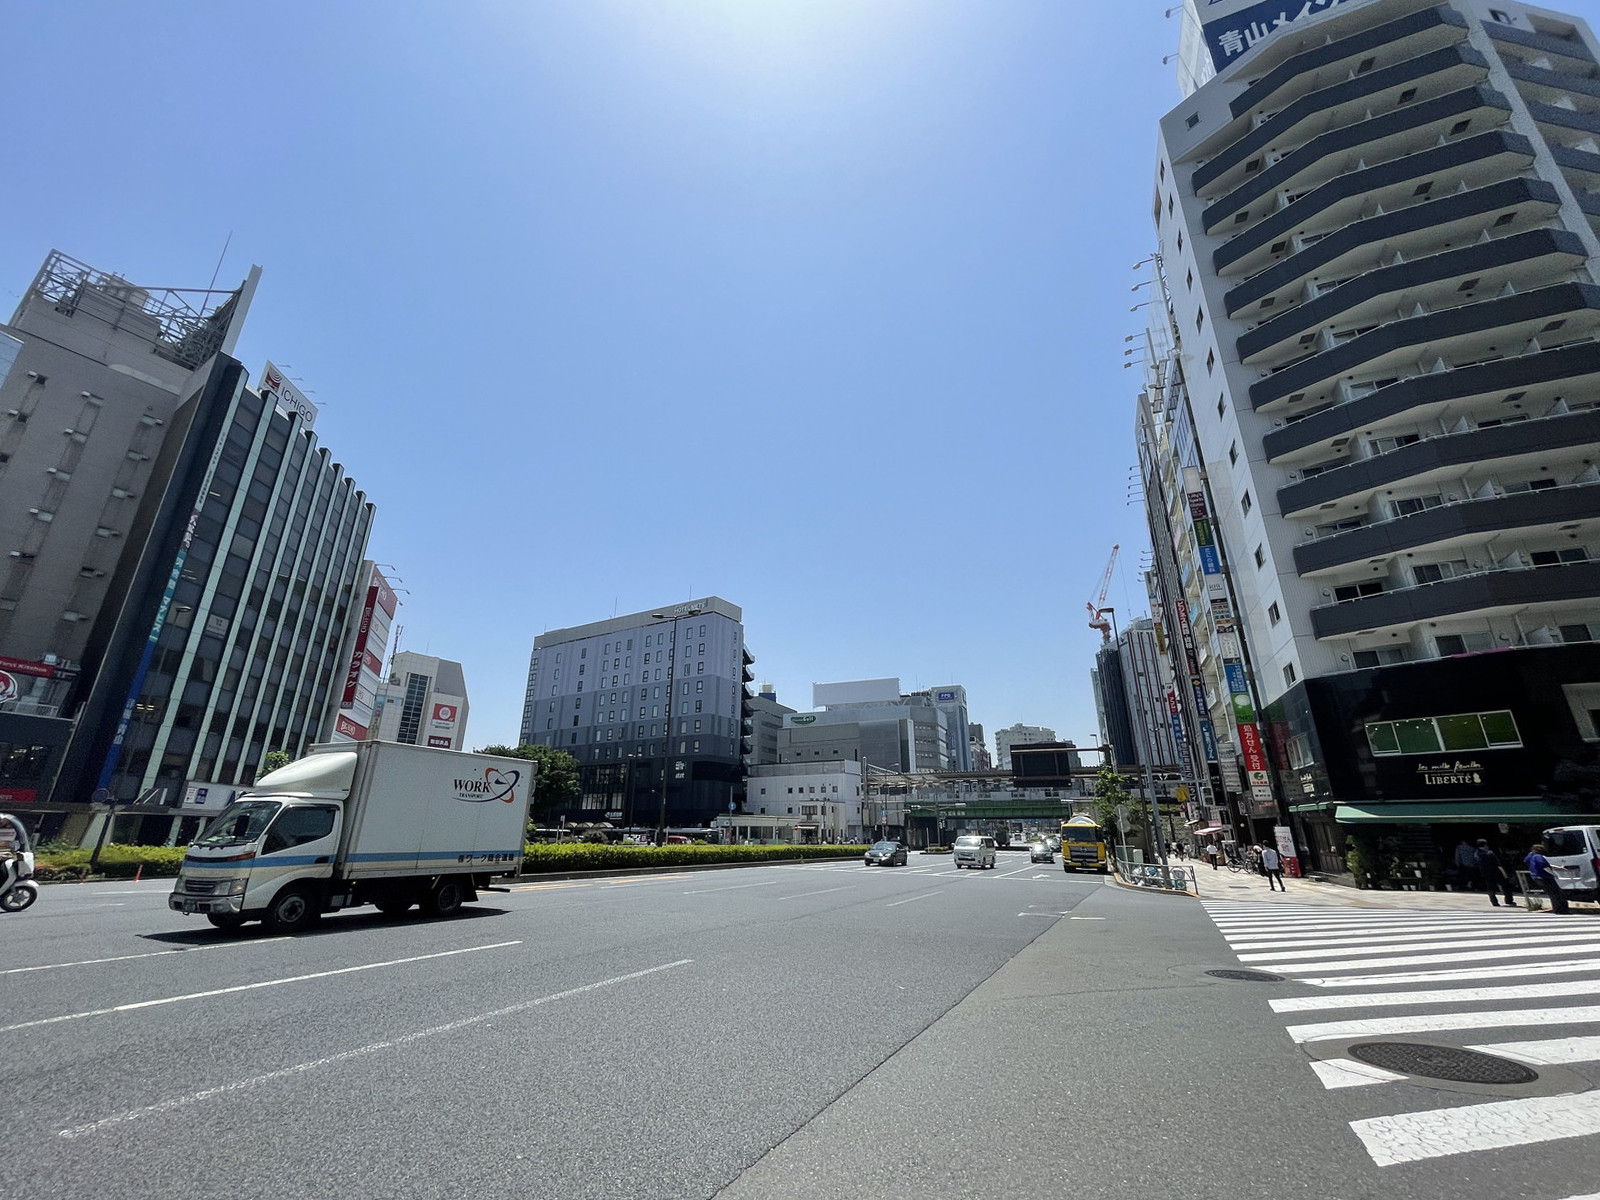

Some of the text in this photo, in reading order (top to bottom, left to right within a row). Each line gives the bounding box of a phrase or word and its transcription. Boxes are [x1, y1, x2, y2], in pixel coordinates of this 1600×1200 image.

[280, 386, 313, 422] ICHIGO
[346, 651, 363, 688] カラオケ
[453, 778, 491, 793] WORK
[1424, 772, 1473, 785] LIBERTÉ
